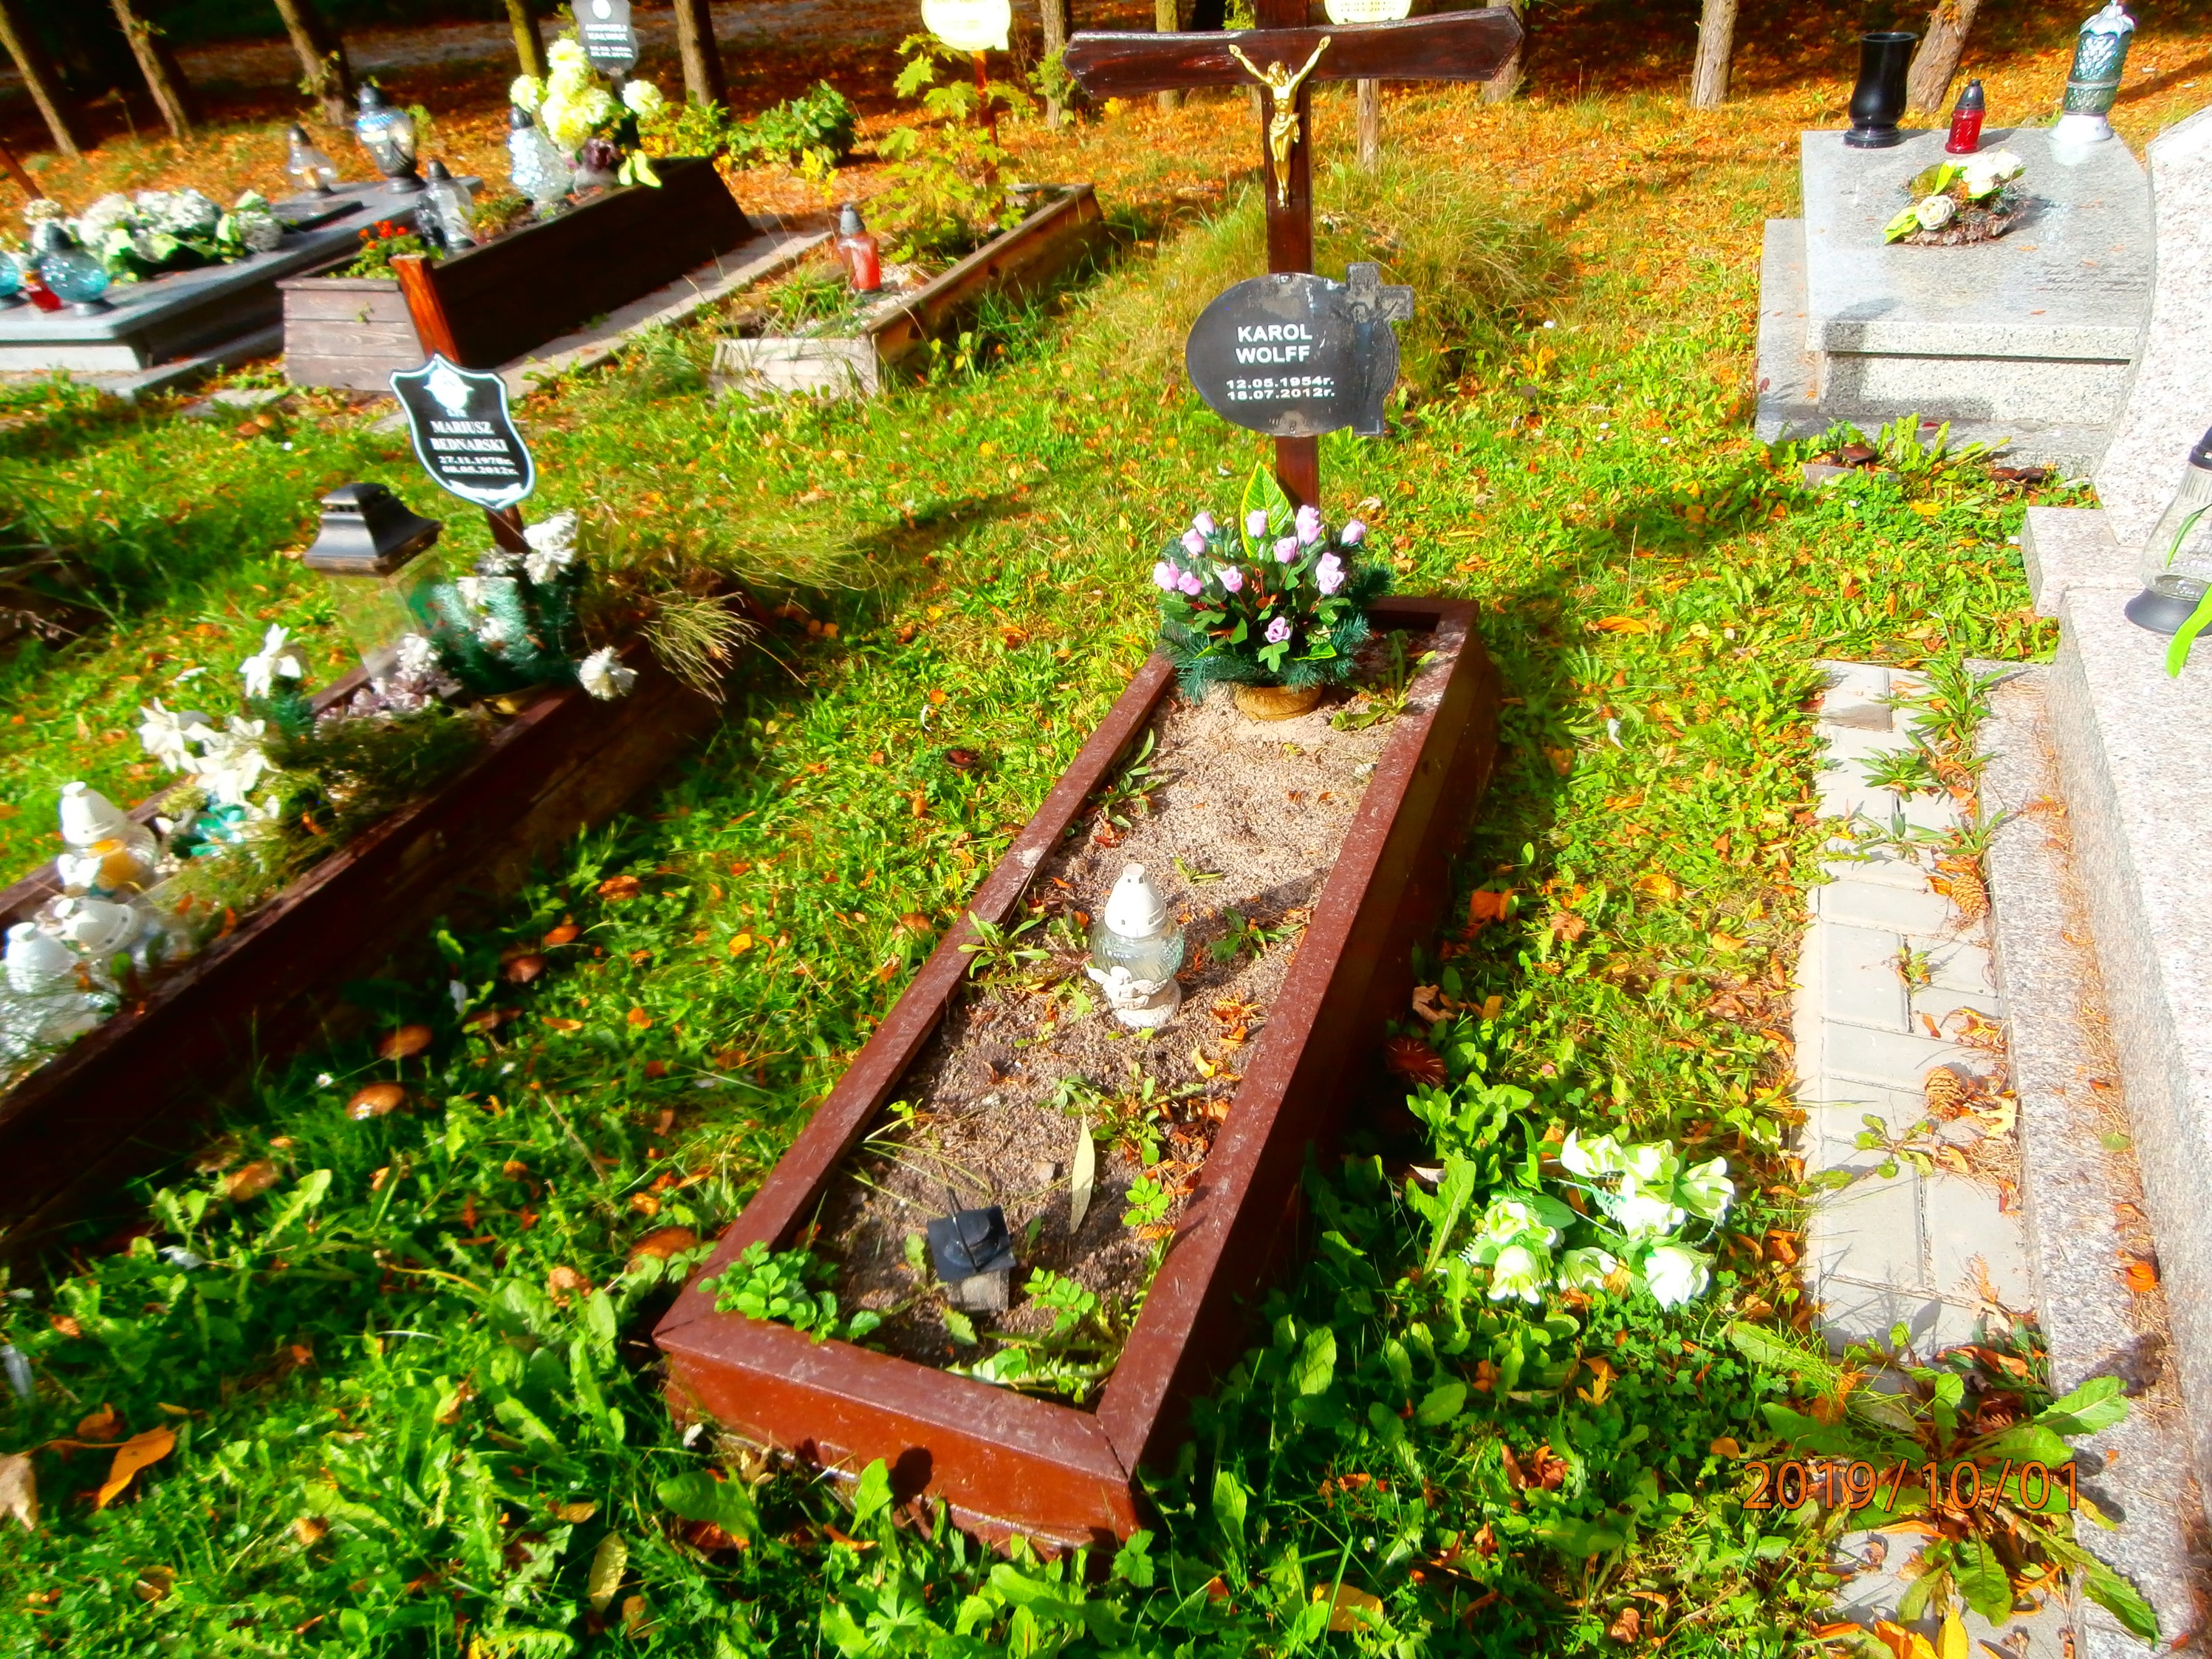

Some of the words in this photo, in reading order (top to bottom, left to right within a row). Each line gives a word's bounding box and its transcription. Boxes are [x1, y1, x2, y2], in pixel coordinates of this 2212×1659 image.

[1237, 324, 1312, 342] KAROL
[1236, 345, 1310, 363] WOLFF
[1226, 376, 1335, 389] 12.05.1954r.
[1227, 388, 1335, 401] 18.07.2012r.
[430, 420, 495, 435] MARIUSZ
[429, 438, 510, 453] BEDNARSKI
